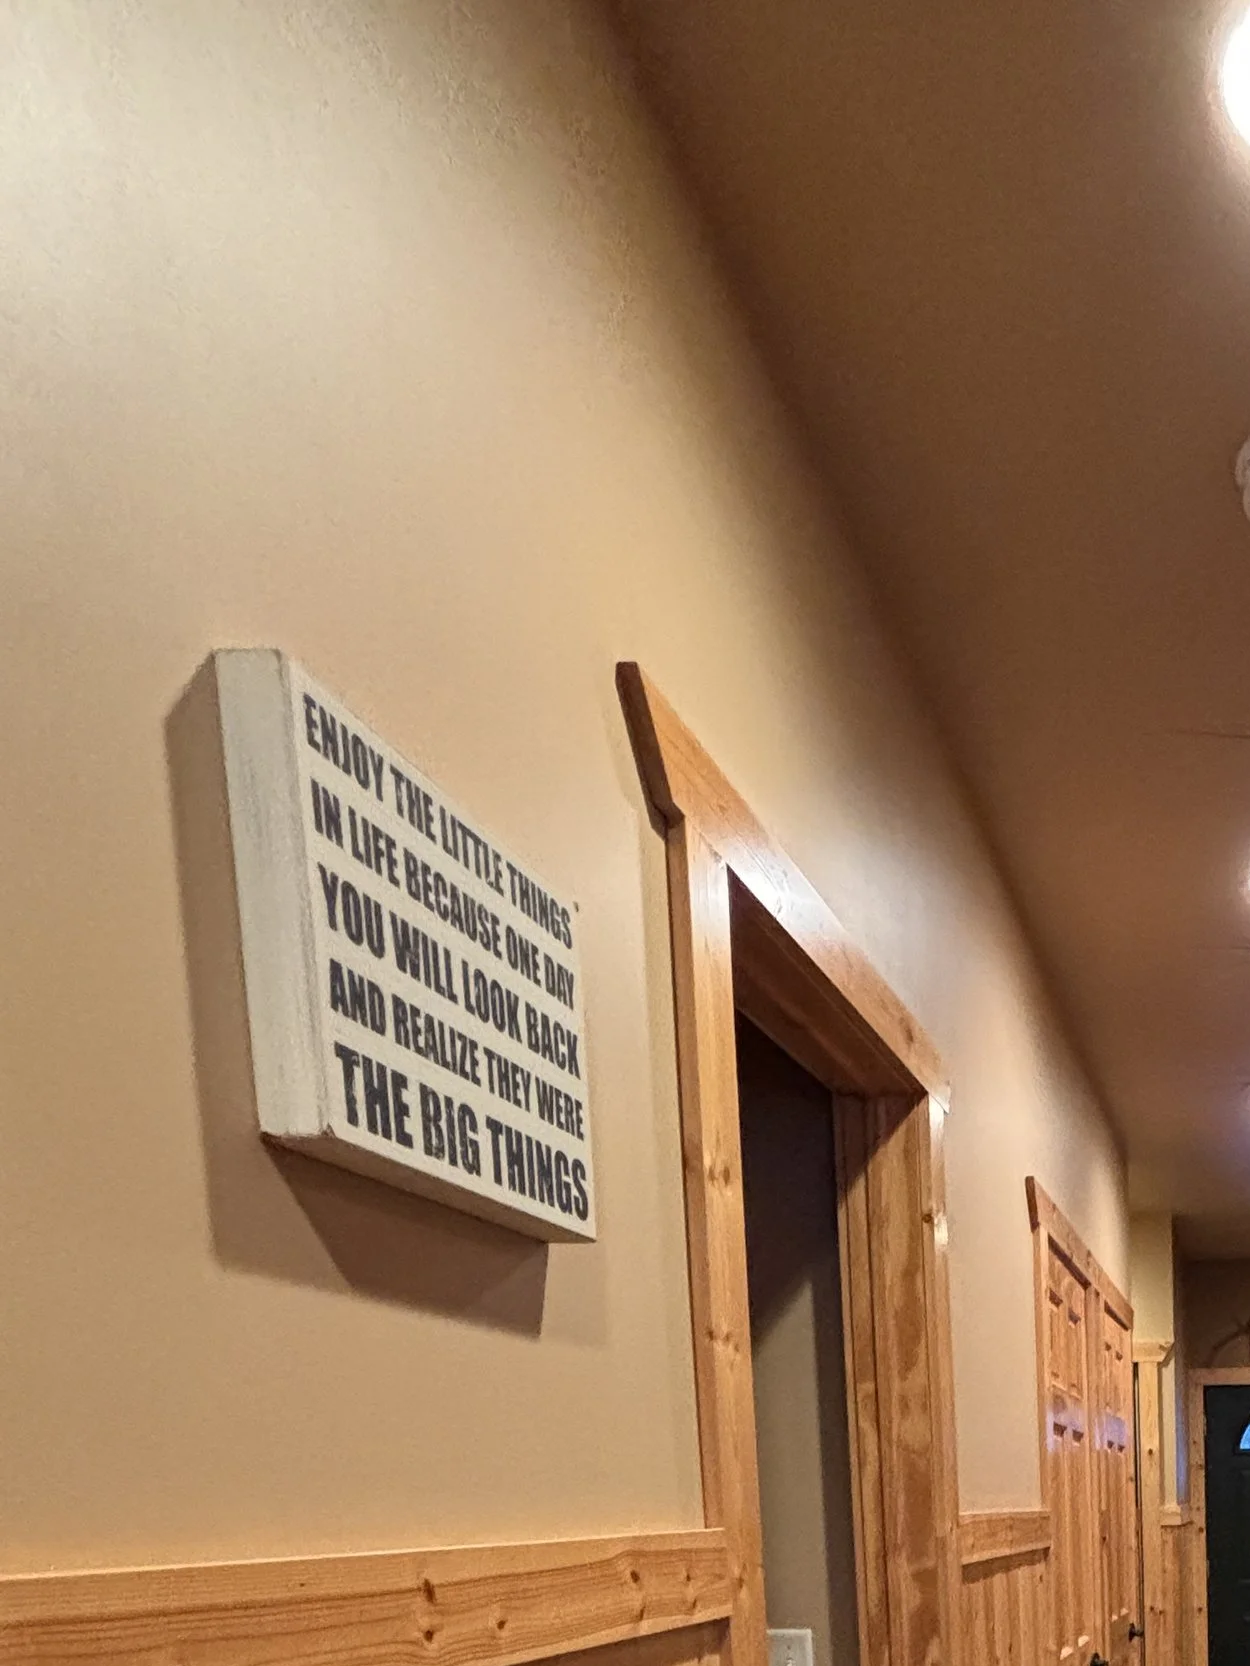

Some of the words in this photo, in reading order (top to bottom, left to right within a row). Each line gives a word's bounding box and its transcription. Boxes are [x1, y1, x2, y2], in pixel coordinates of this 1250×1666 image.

[303, 693, 384, 801] ENJOY
[389, 764, 437, 844] THE
[439, 805, 504, 897] LITTLE
[506, 861, 573, 950] THINGS
[310, 778, 344, 849] IN
[348, 805, 400, 888] LIFE
[403, 847, 503, 960] BECAUSE
[505, 925, 541, 987] ONE
[543, 953, 574, 1011] DAY
[317, 862, 385, 960] YOU
[389, 910, 458, 1005] WILL
[461, 959, 522, 1044] LOOK
[525, 1001, 581, 1080] BACK
[329, 957, 387, 1037] AND
[391, 993, 482, 1087] REALIZE
[483, 1046, 531, 1113] THEY
[535, 1076, 584, 1141] WERE
[334, 1041, 414, 1150] THE
[419, 1082, 481, 1177] BIG
[485, 1115, 589, 1222] THINGS
